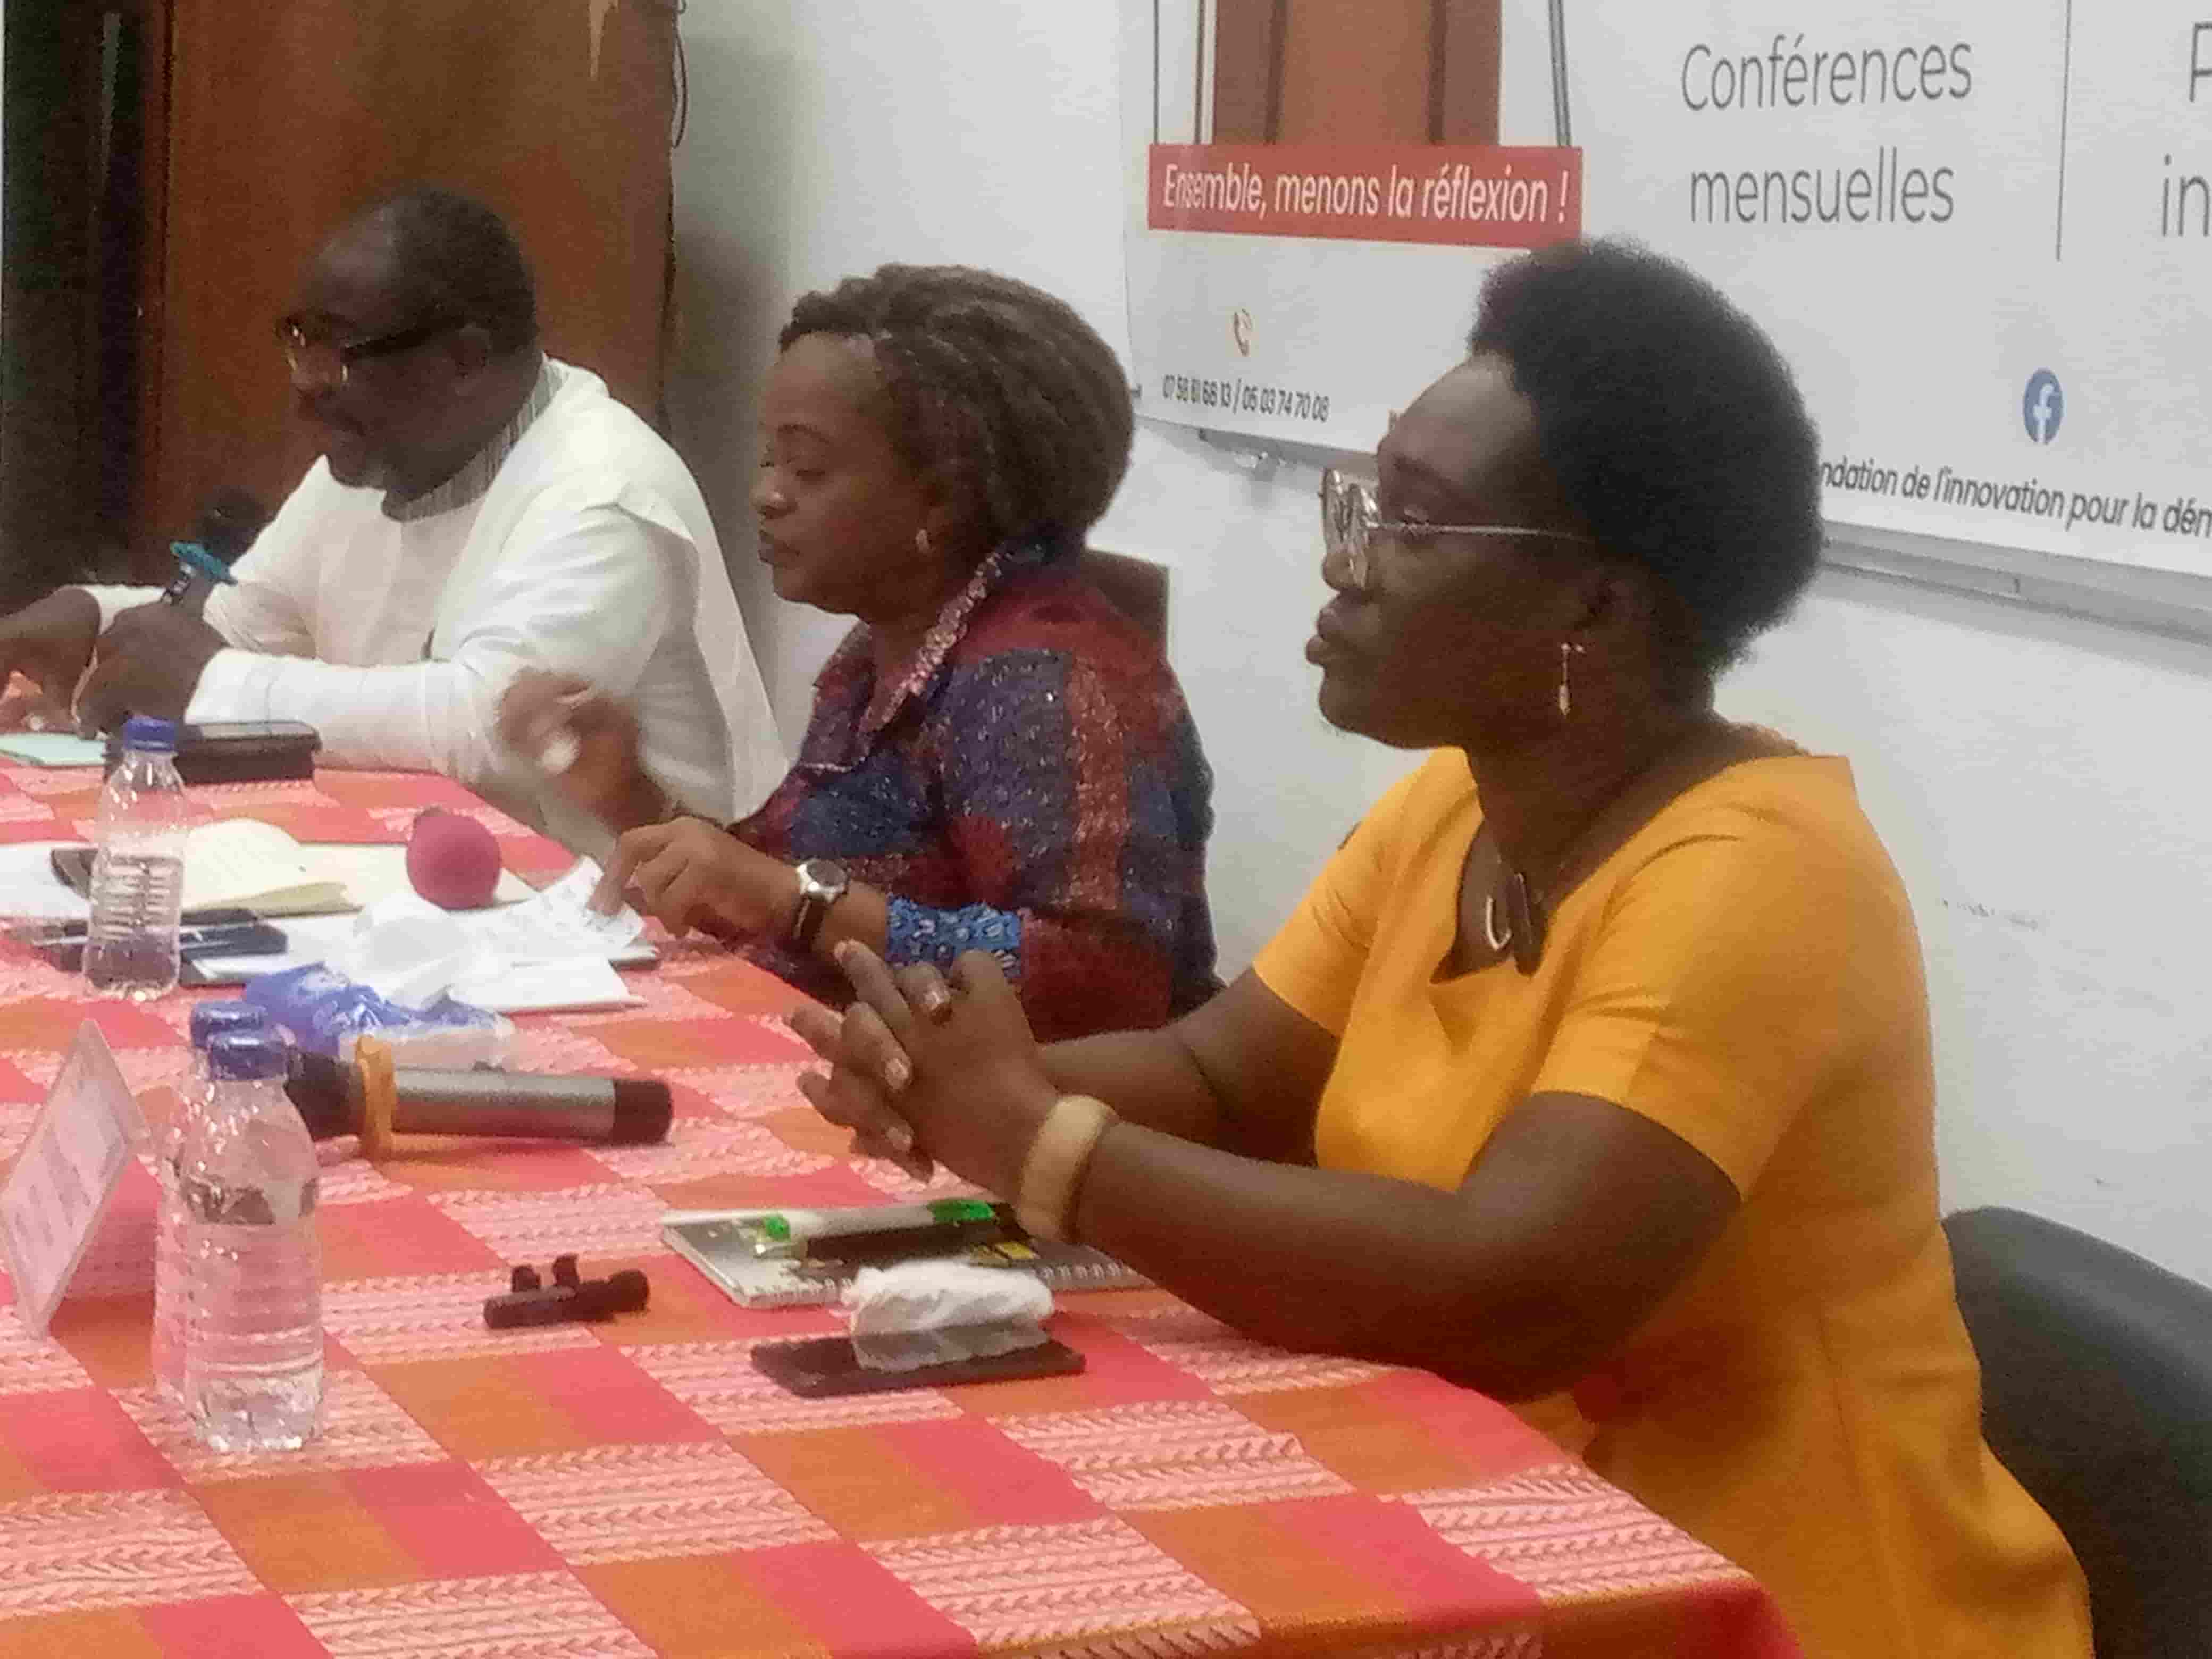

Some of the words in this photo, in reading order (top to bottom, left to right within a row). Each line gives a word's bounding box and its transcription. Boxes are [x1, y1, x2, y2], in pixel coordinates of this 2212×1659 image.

[1681, 33, 1972, 111] Conférences
[1163, 162, 1267, 220] Ensemble,
[1275, 174, 1381, 216] menons
[1387, 164, 1414, 220] la
[1421, 162, 1548, 223] réflexion
[1557, 170, 1569, 224] !
[1690, 146, 1955, 223] mensuelles
[1278, 389, 1293, 416] 74
[1295, 392, 1311, 420] 70
[1901, 464, 1931, 500] de
[1933, 465, 2065, 518] l'innovation
[2064, 492, 2129, 532] pour
[2132, 491, 2157, 530] la
